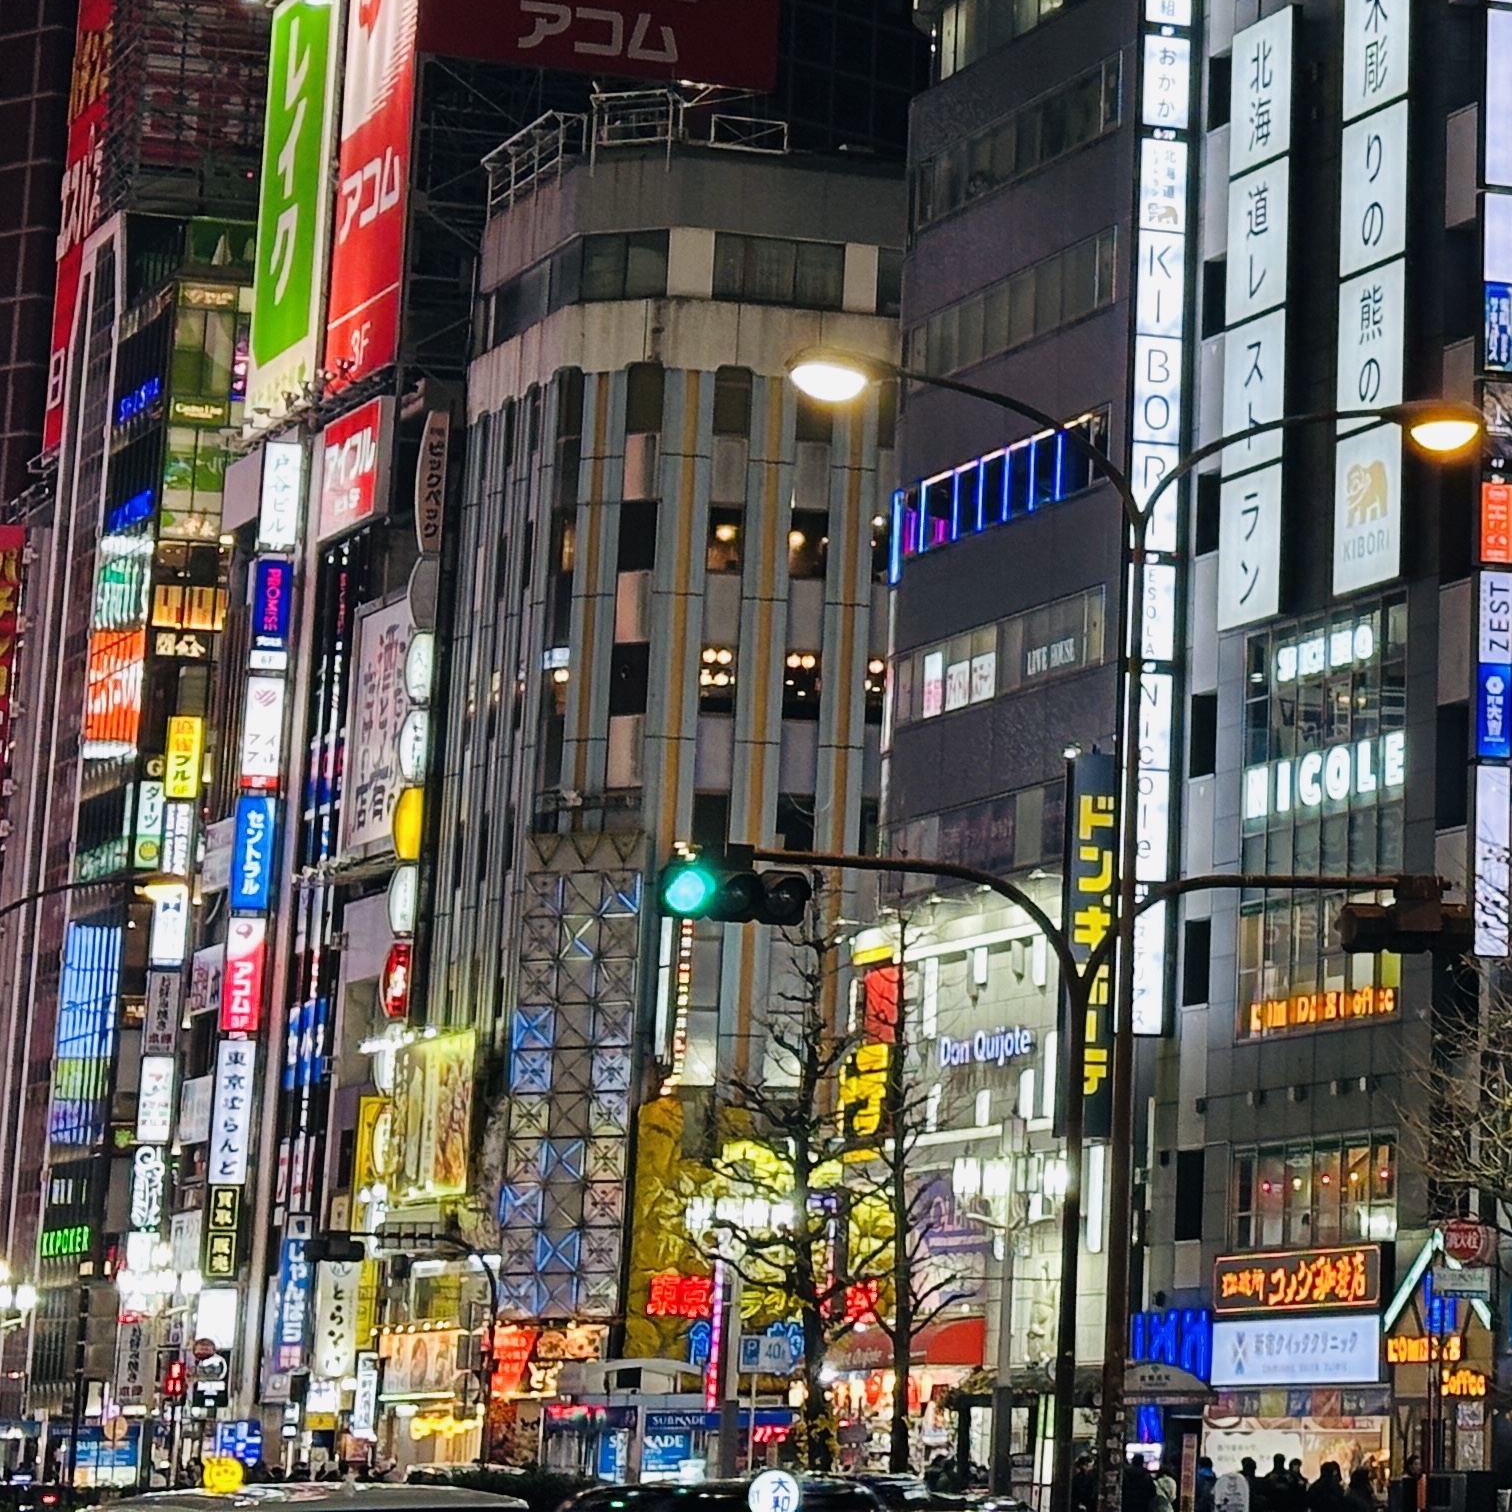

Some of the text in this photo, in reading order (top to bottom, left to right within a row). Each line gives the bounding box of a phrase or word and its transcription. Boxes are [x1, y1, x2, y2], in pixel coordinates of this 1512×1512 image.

[517, 0, 679, 63] アコム
[267, 16, 311, 306] レイク
[338, 147, 400, 246] アコム
[1240, 39, 1273, 606] 北海道レストラン
[323, 424, 377, 492] アイフル
[268, 453, 291, 535] 戸谷ビル
[1343, 528, 1391, 563] KIBORI
[263, 567, 283, 632] PROMISE
[1145, 568, 1158, 656] ESOLA
[1489, 581, 1510, 653] ZEST
[144, 785, 161, 829] ダーツ
[1244, 731, 1405, 820] NICOLE
[241, 809, 265, 896] セントラル
[231, 960, 255, 1014] アコム
[938, 1024, 1033, 1067] Don Quijote
[645, 1273, 712, 1319] 東京
